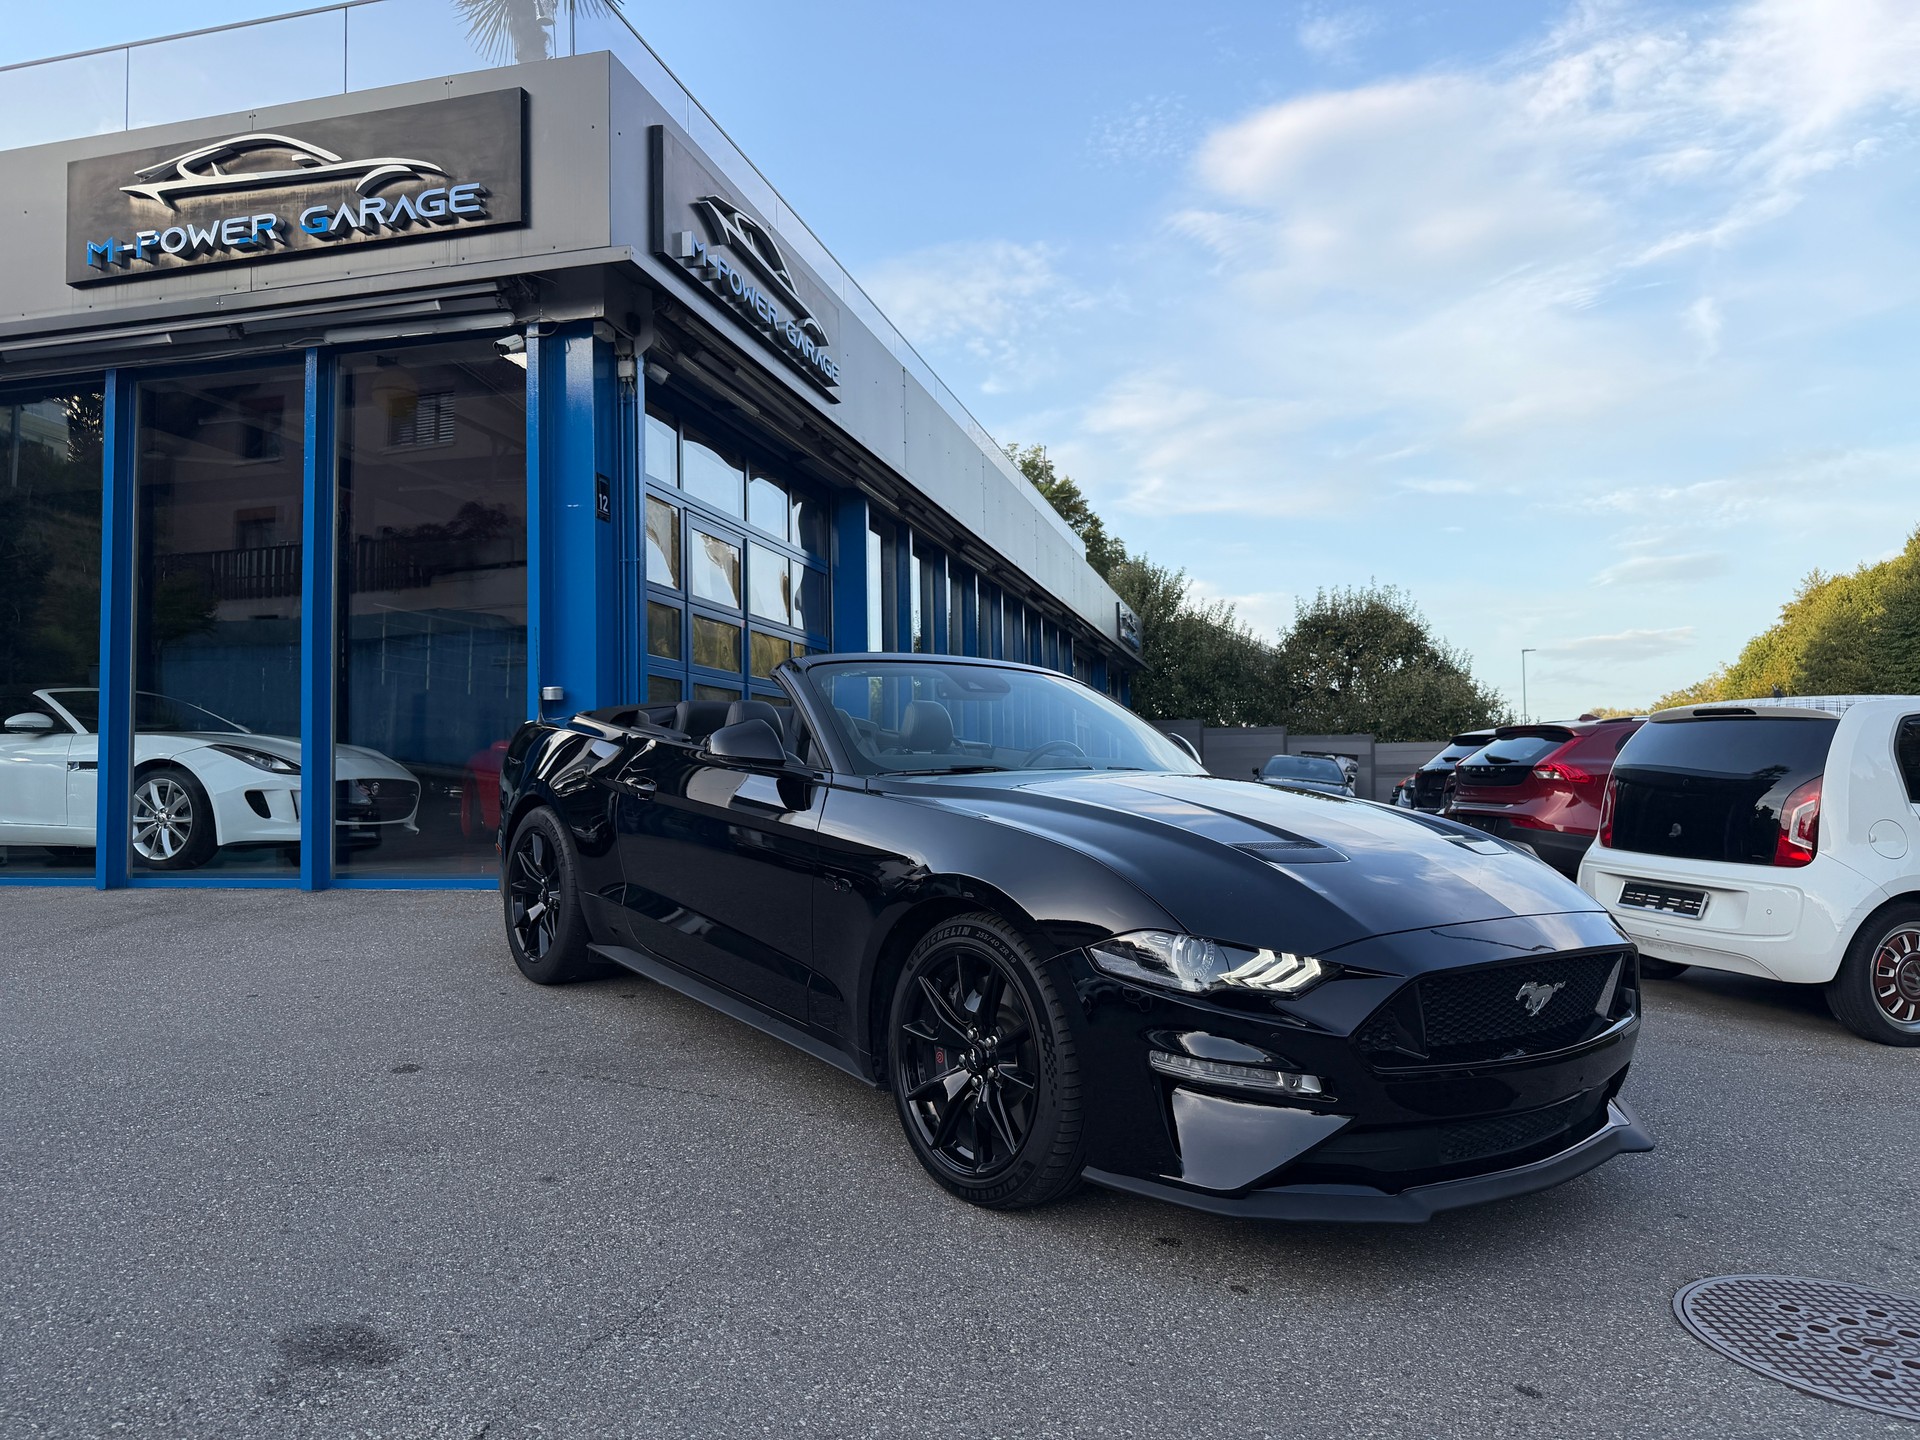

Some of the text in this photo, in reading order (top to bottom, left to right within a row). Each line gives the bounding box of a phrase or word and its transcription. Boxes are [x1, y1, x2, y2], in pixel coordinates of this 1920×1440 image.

[87, 182, 480, 265] M-POWER GARAGE
[691, 235, 841, 380] M-POWER GARAGE
[599, 493, 609, 513] 12
[919, 926, 971, 954] MICHELIN
[976, 931, 1000, 947] 255/40
[1000, 945, 1010, 956] ZR
